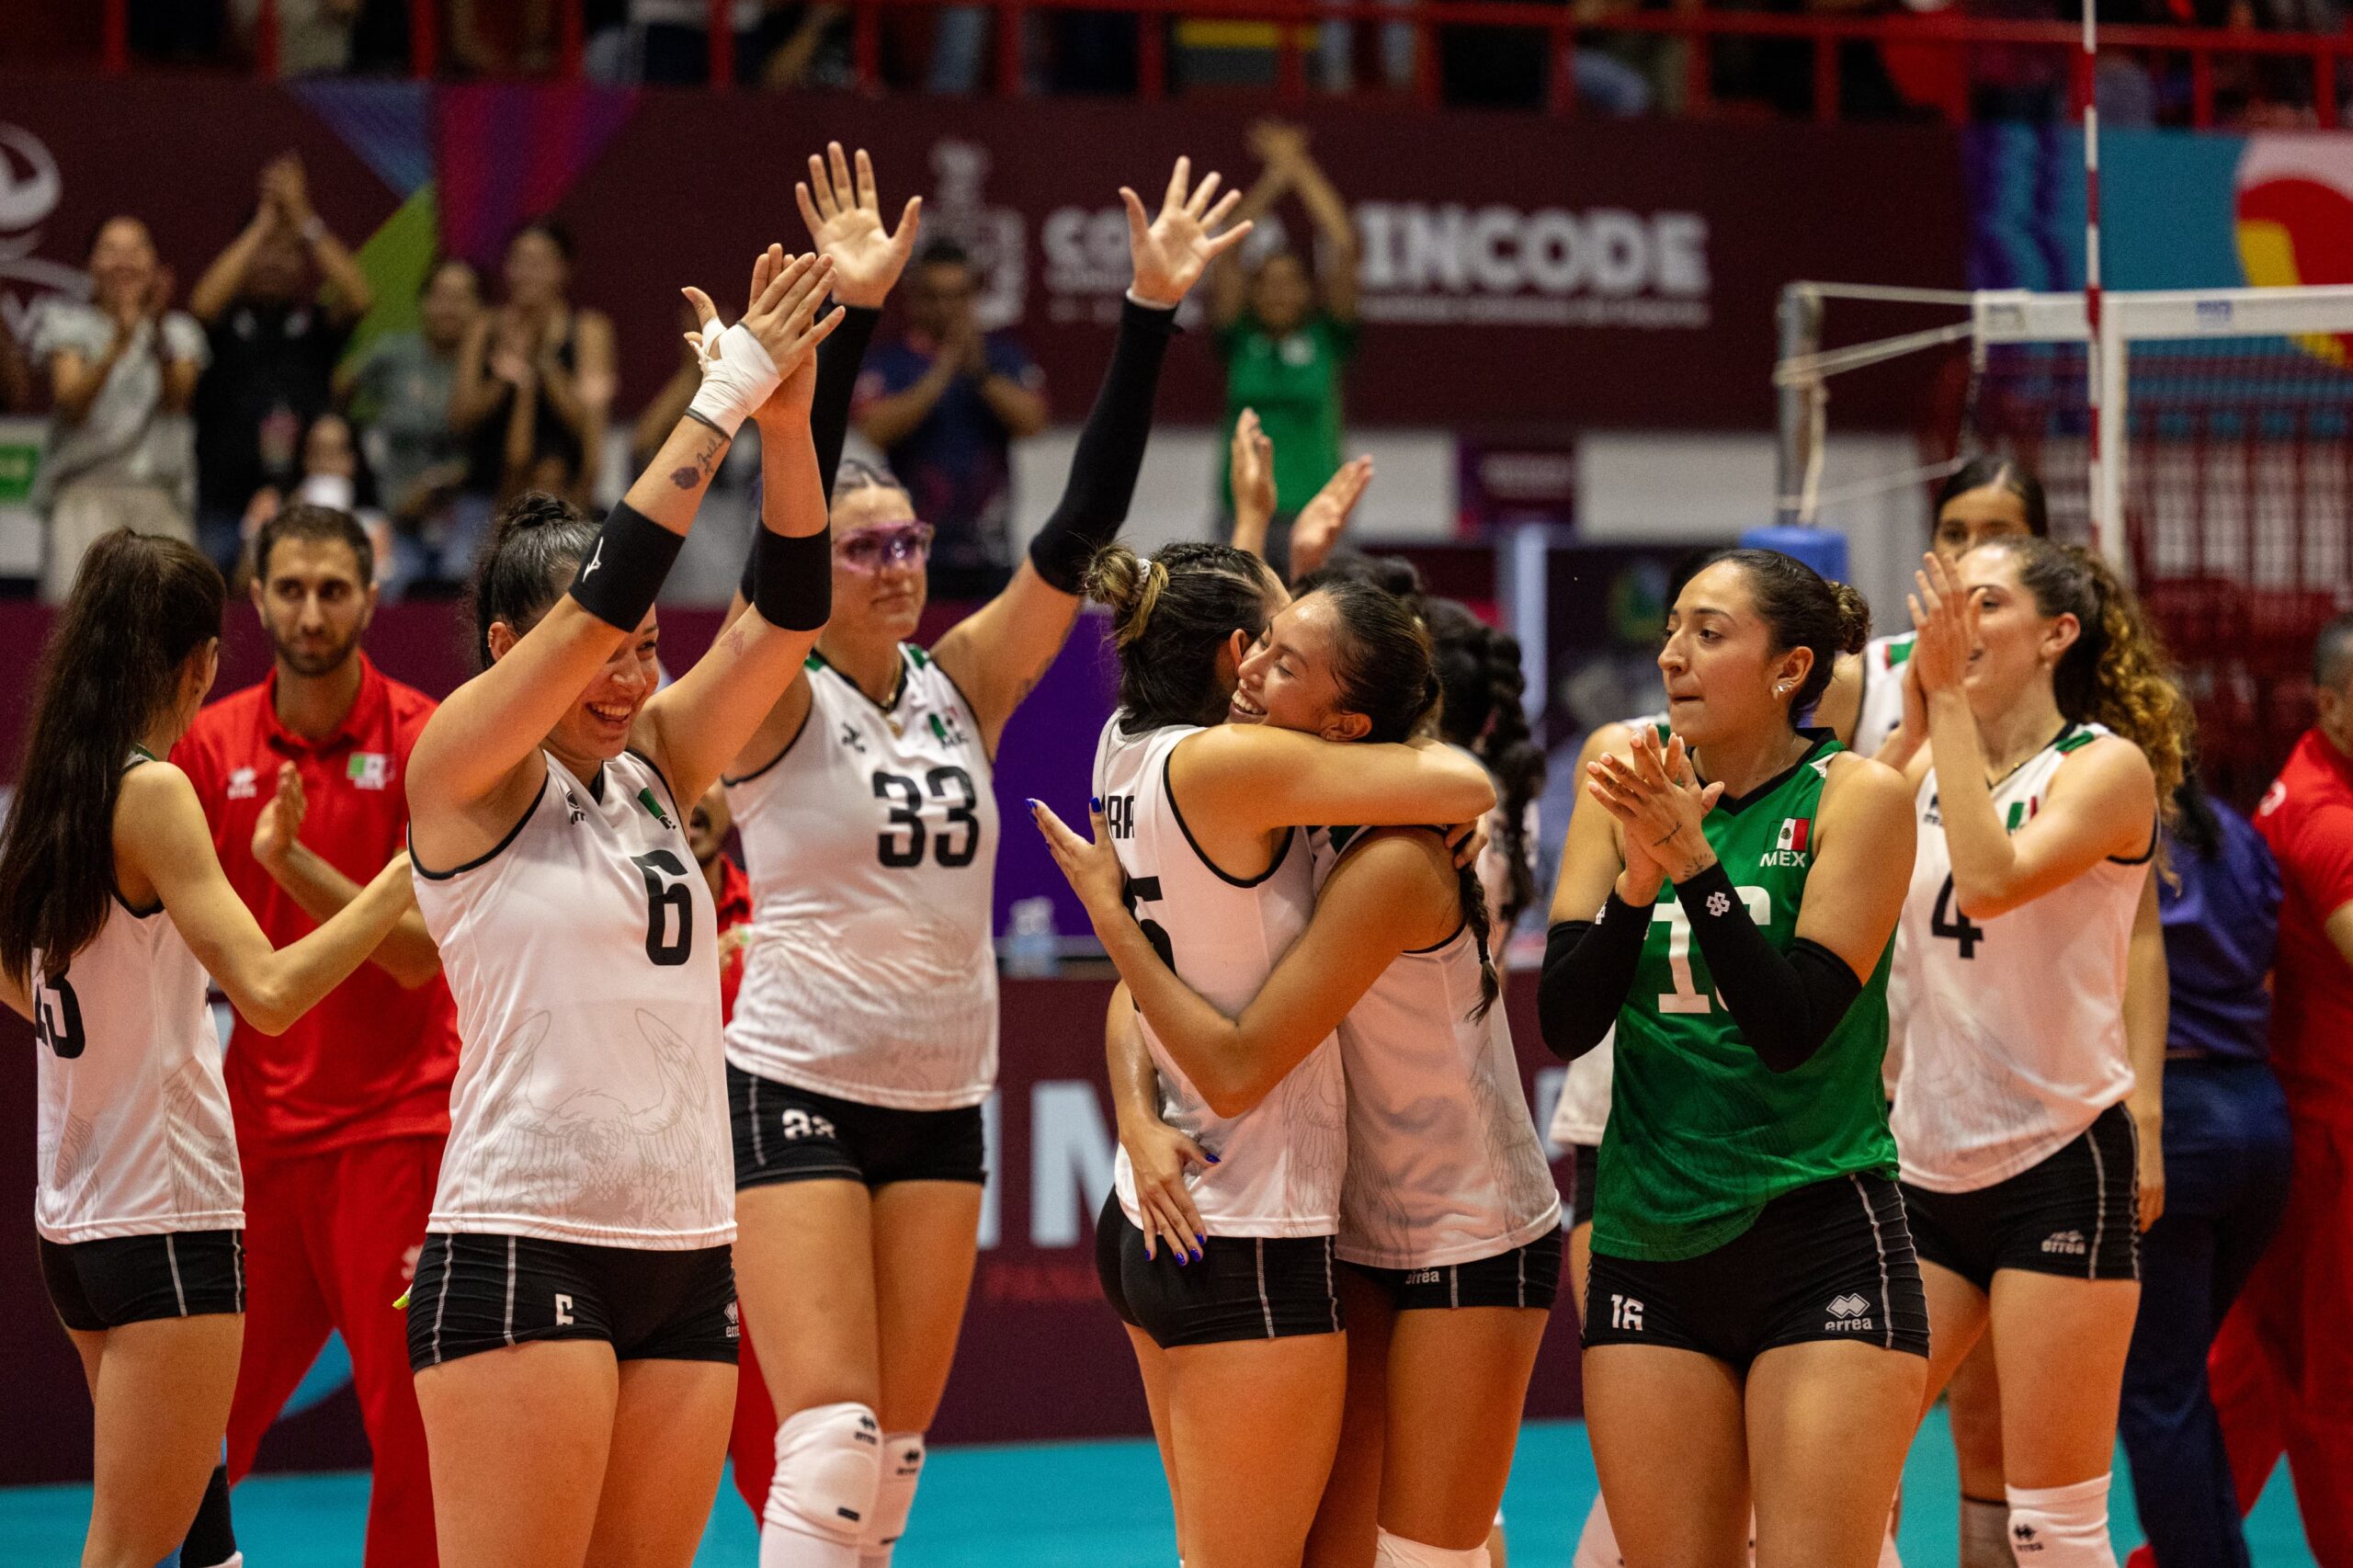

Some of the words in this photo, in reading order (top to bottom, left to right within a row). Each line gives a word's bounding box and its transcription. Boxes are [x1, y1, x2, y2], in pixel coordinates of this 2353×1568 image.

[1360, 203, 1709, 293] INCODE
[872, 766, 980, 868] 33
[1759, 851, 1806, 869] MEX
[630, 849, 692, 966] 6
[1931, 871, 1984, 960] 4
[1824, 1317, 1873, 1332] errea
